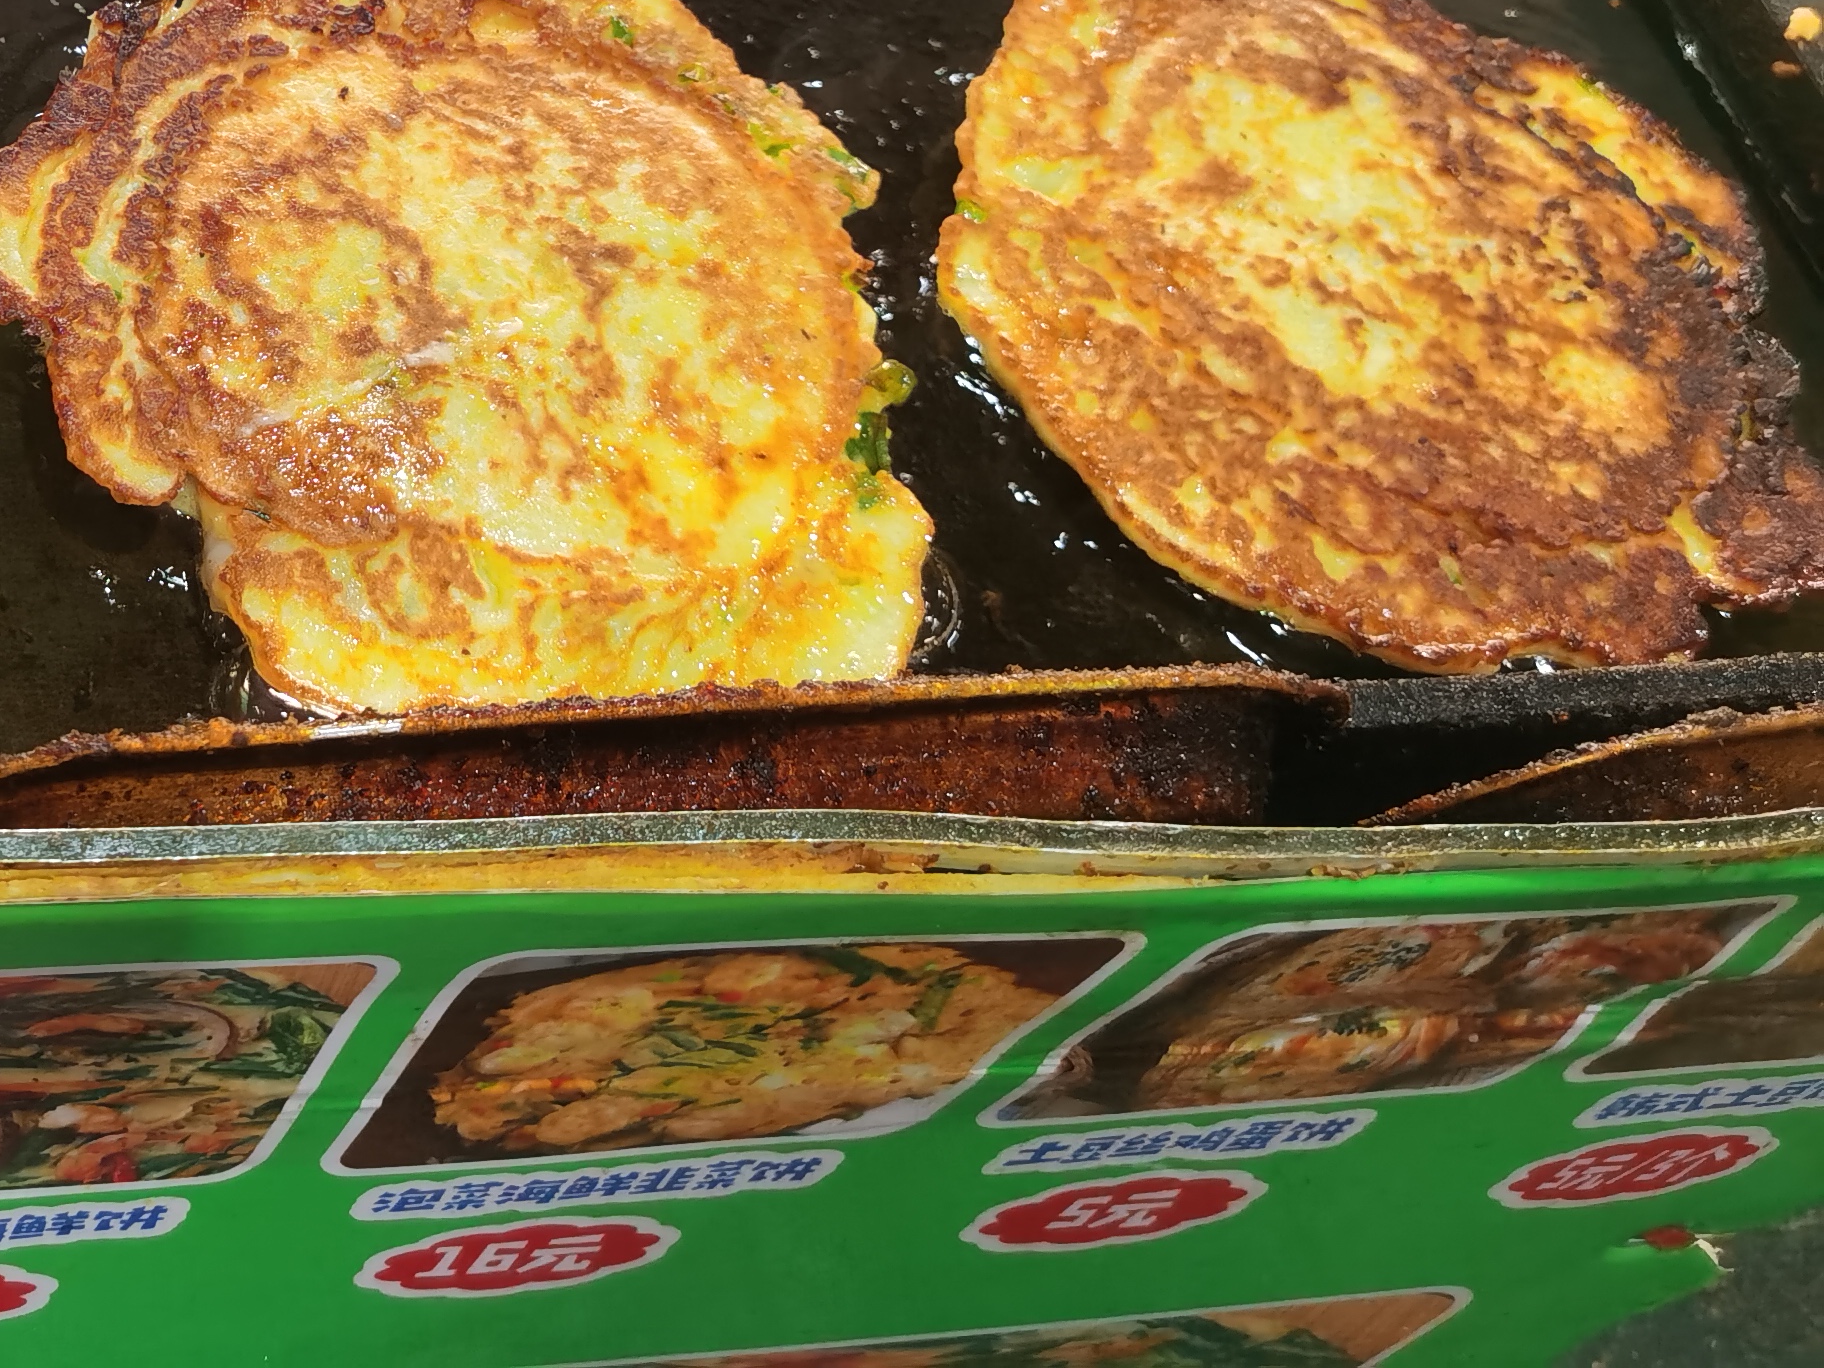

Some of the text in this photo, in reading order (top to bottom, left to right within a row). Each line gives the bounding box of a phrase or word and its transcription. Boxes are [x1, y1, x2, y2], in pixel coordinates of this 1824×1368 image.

[1002, 1116, 1356, 1167] 土豆丝鸡蛋饼
[371, 1157, 823, 1214] 泡菜海鲜韭菜饼
[1044, 1187, 1182, 1232] 5元
[413, 1232, 606, 1280] 16元
